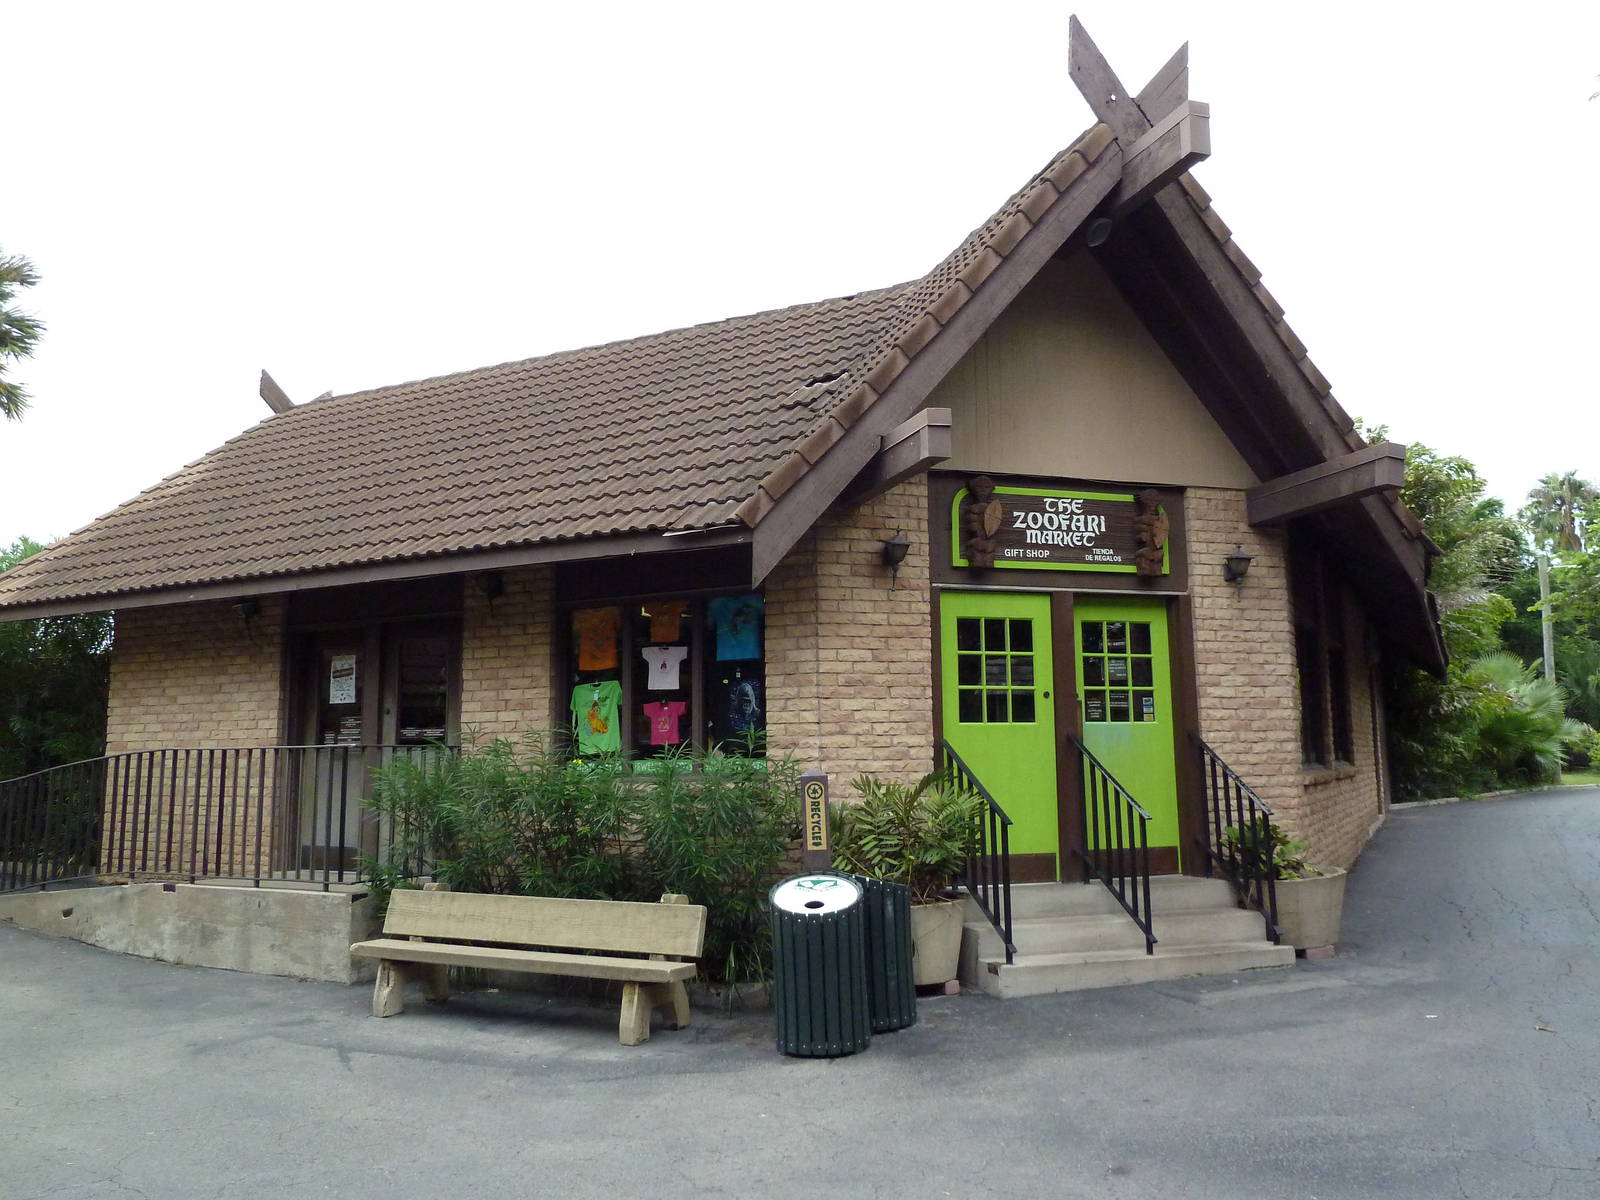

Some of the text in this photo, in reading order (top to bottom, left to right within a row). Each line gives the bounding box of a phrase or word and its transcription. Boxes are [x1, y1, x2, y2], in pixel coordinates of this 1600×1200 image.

[1043, 497, 1084, 514] THE
[1012, 511, 1106, 535] ZOOFARI
[1026, 529, 1096, 547] MARKET
[1004, 548, 1050, 558] GIFT SHOP
[810, 800, 822, 841] RECYCLE
